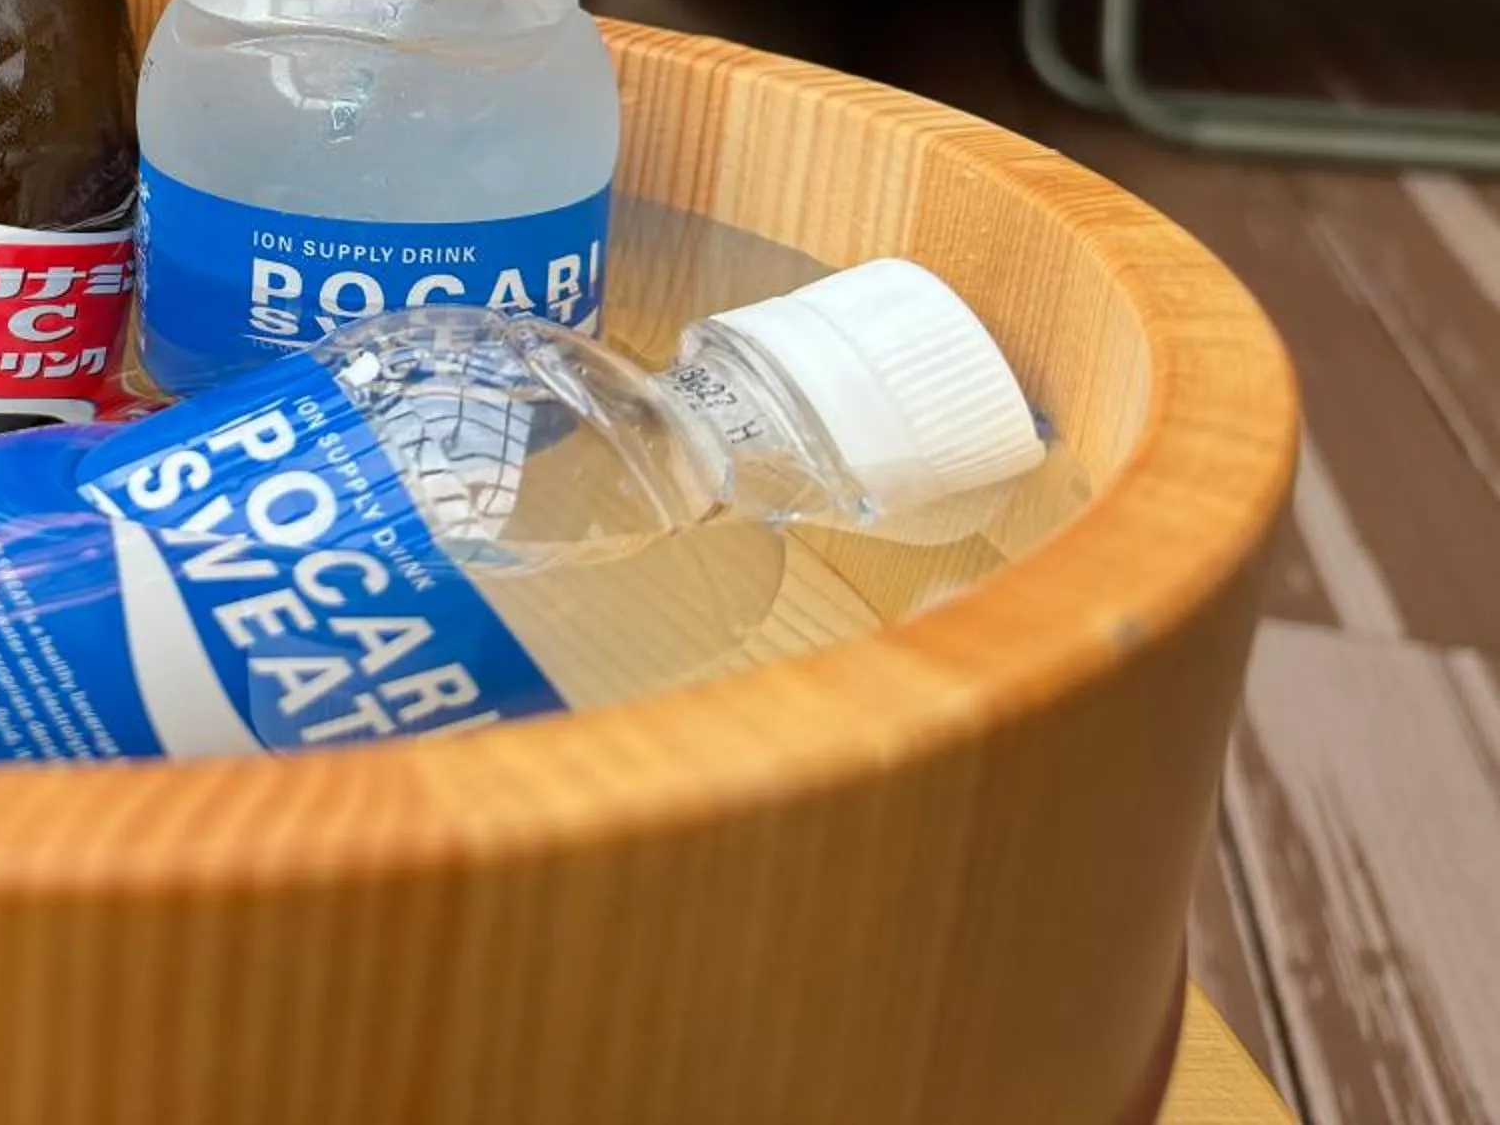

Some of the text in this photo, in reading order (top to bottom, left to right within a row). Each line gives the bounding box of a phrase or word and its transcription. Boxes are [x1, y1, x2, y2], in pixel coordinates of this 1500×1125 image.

[250, 239, 599, 319] POCARI
[253, 230, 477, 264] ION SUPPLY DRINK
[8, 304, 77, 342] C
[294, 393, 325, 432] ION
[316, 432, 386, 521] SUPPLY
[127, 449, 398, 742] SWEAT
[207, 407, 500, 742] POCARI
